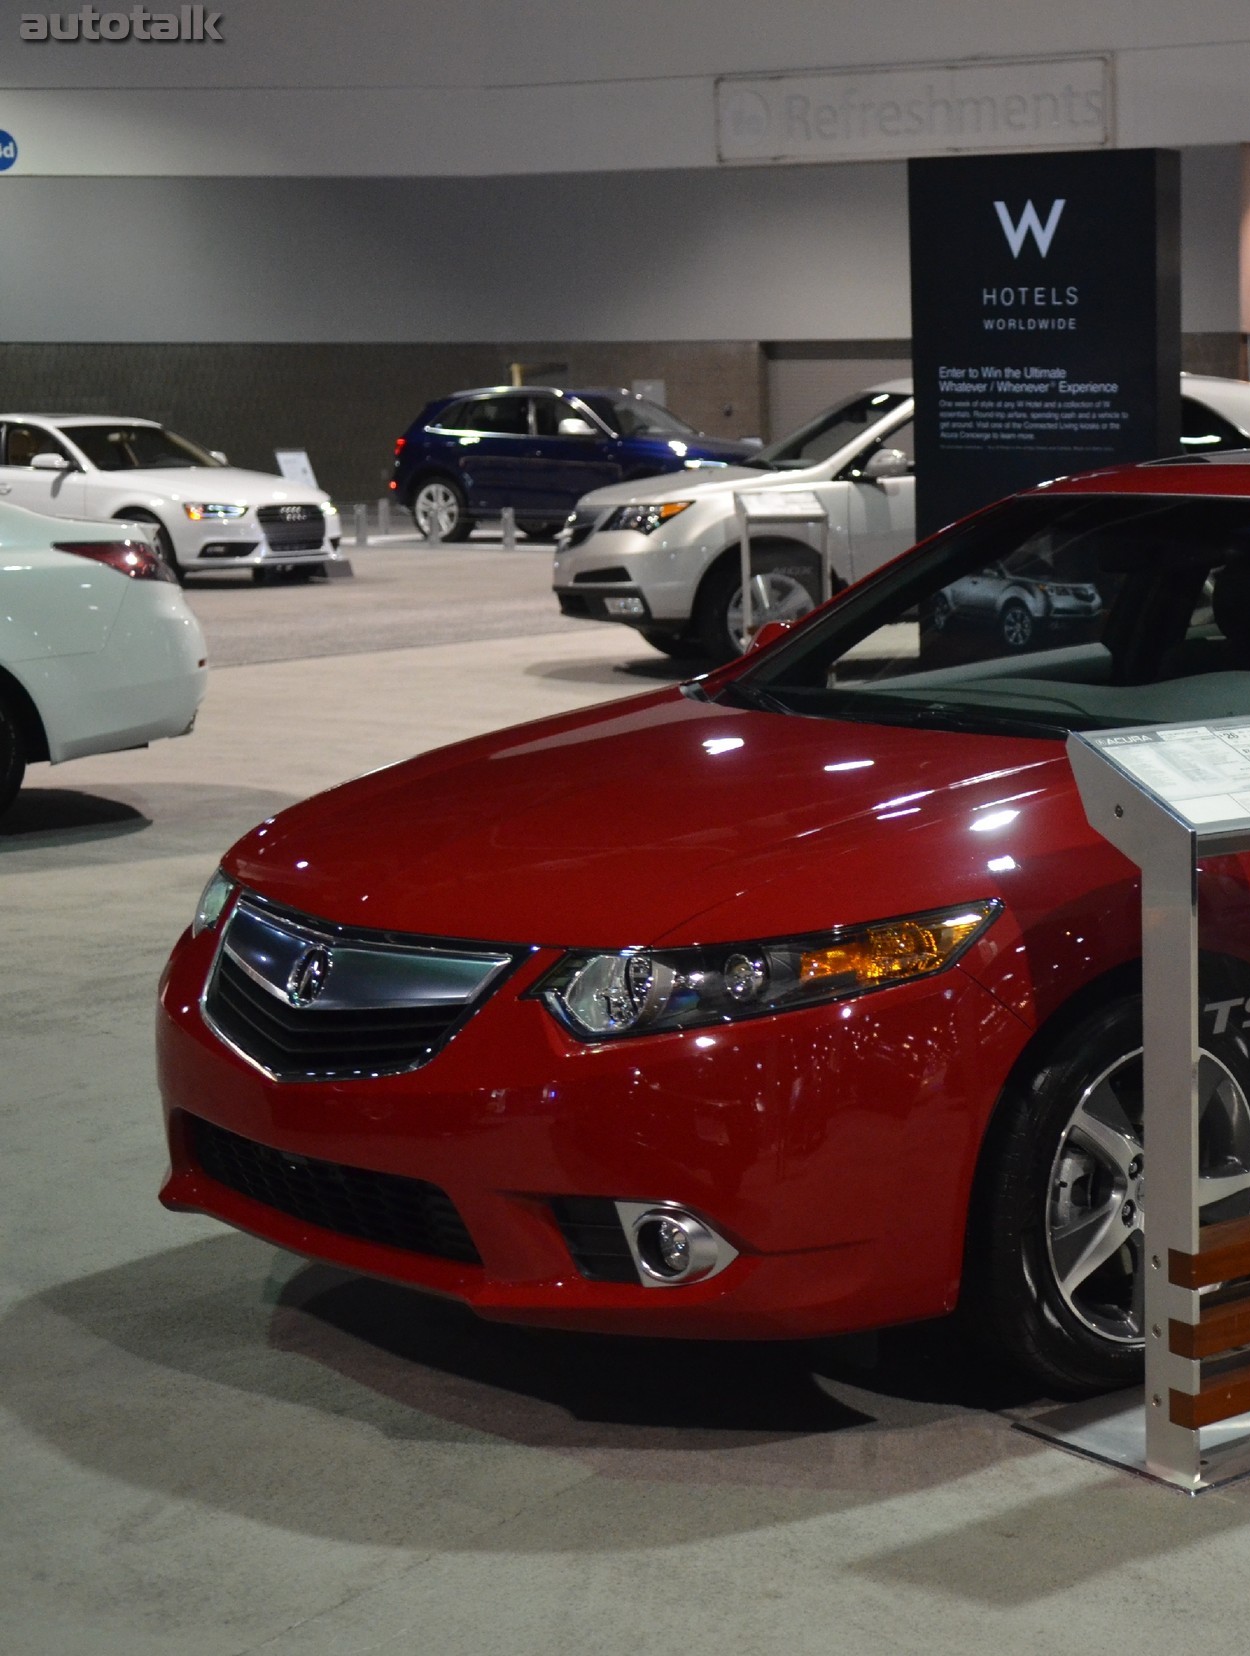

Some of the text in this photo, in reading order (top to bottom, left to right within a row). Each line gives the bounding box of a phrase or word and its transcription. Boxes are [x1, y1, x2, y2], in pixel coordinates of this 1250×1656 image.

[784, 83, 1102, 141] Refreshments
[0, 142, 14, 158] d
[993, 199, 1066, 259] W
[982, 286, 1079, 306] HOTELS
[983, 318, 1077, 330] WORLDWIDE
[939, 366, 1067, 379] Enter to Win the Ultimate
[939, 380, 987, 392] Whatever
[1058, 381, 1119, 395] Experience
[939, 399, 953, 408] One
[972, 400, 979, 408] of
[980, 400, 994, 409] style
[1025, 400, 1042, 408] Hotel
[1043, 400, 1057, 409] and
[1063, 400, 1093, 409] collection
[1094, 400, 1102, 409] of
[1030, 412, 1059, 421] spending
[1023, 421, 1058, 430] Connected
[1059, 422, 1078, 432] Living
[1106, 733, 1153, 746] ACURA
